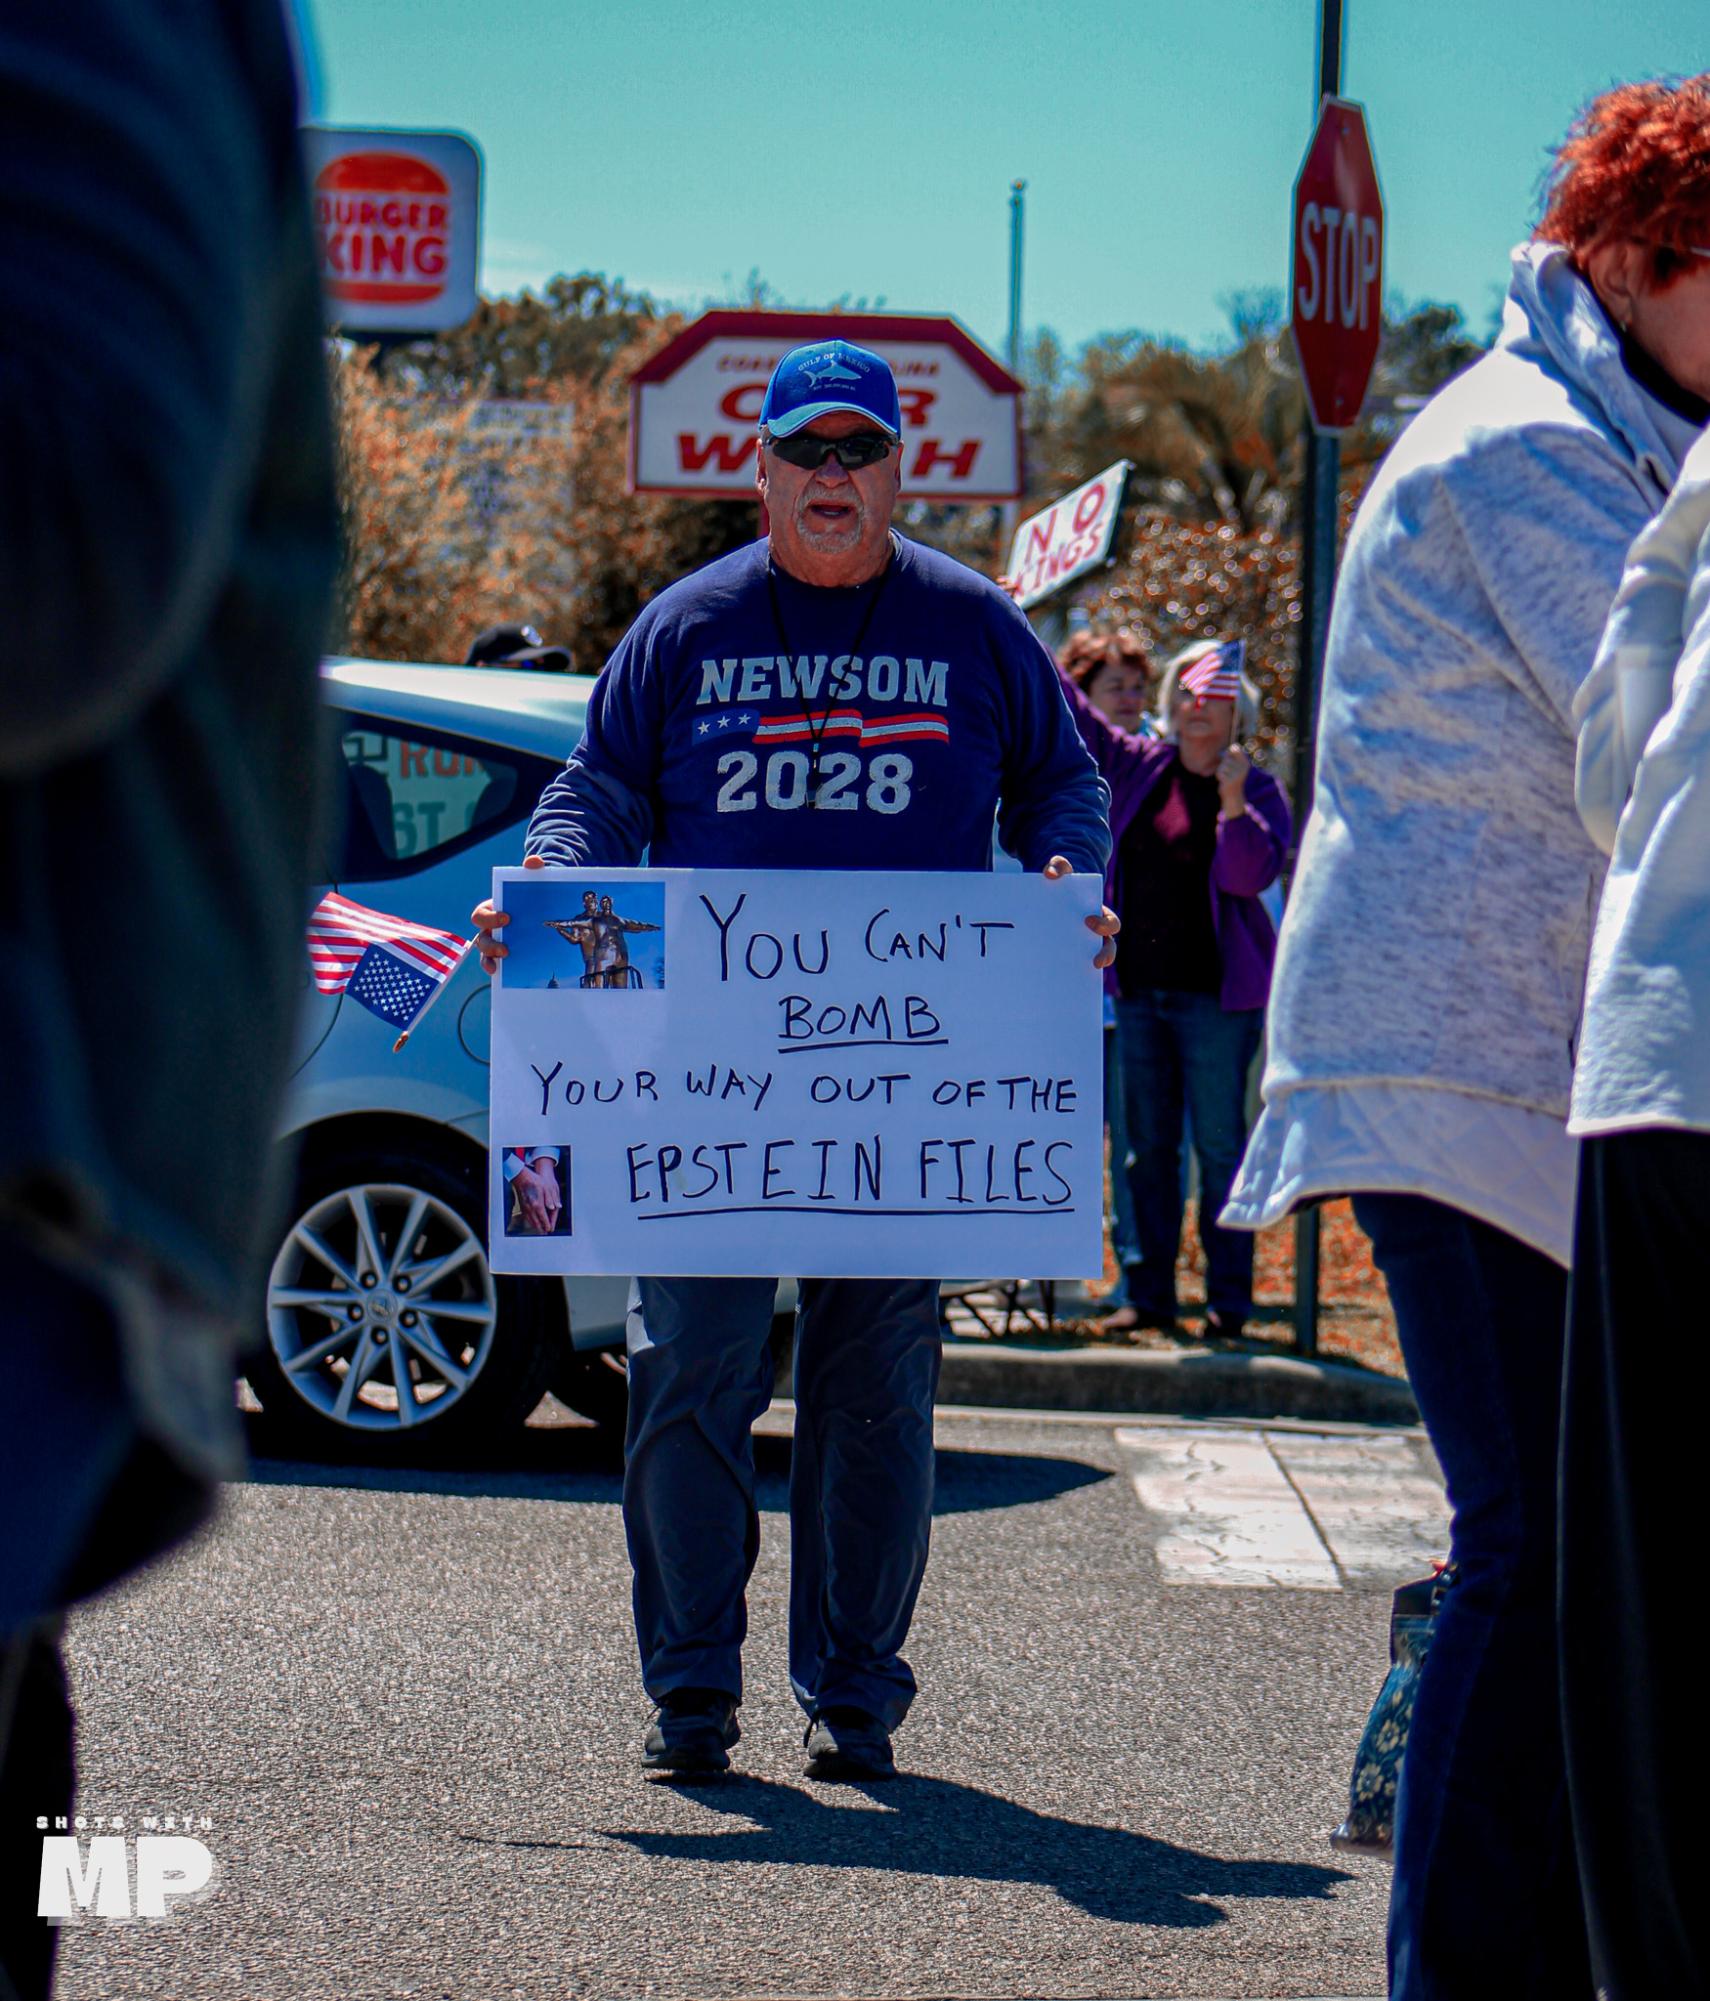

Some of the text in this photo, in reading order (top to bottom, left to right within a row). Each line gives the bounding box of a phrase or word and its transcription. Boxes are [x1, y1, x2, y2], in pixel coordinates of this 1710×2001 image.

[320, 232, 447, 275] KING
[1299, 202, 1378, 330] STOP
[798, 356, 821, 371] GULF
[720, 381, 936, 427] CR
[677, 432, 980, 479] WH
[1025, 484, 1106, 571] NO
[696, 655, 949, 707] NEWSOM
[716, 751, 913, 815] 2028
[699, 893, 1015, 982] YOU CAN'T
[778, 995, 941, 1040] BOMB
[531, 1061, 1077, 1116] YOUR WAY OUT OF THE
[627, 1134, 1074, 1206] EPSTEIN FILES
